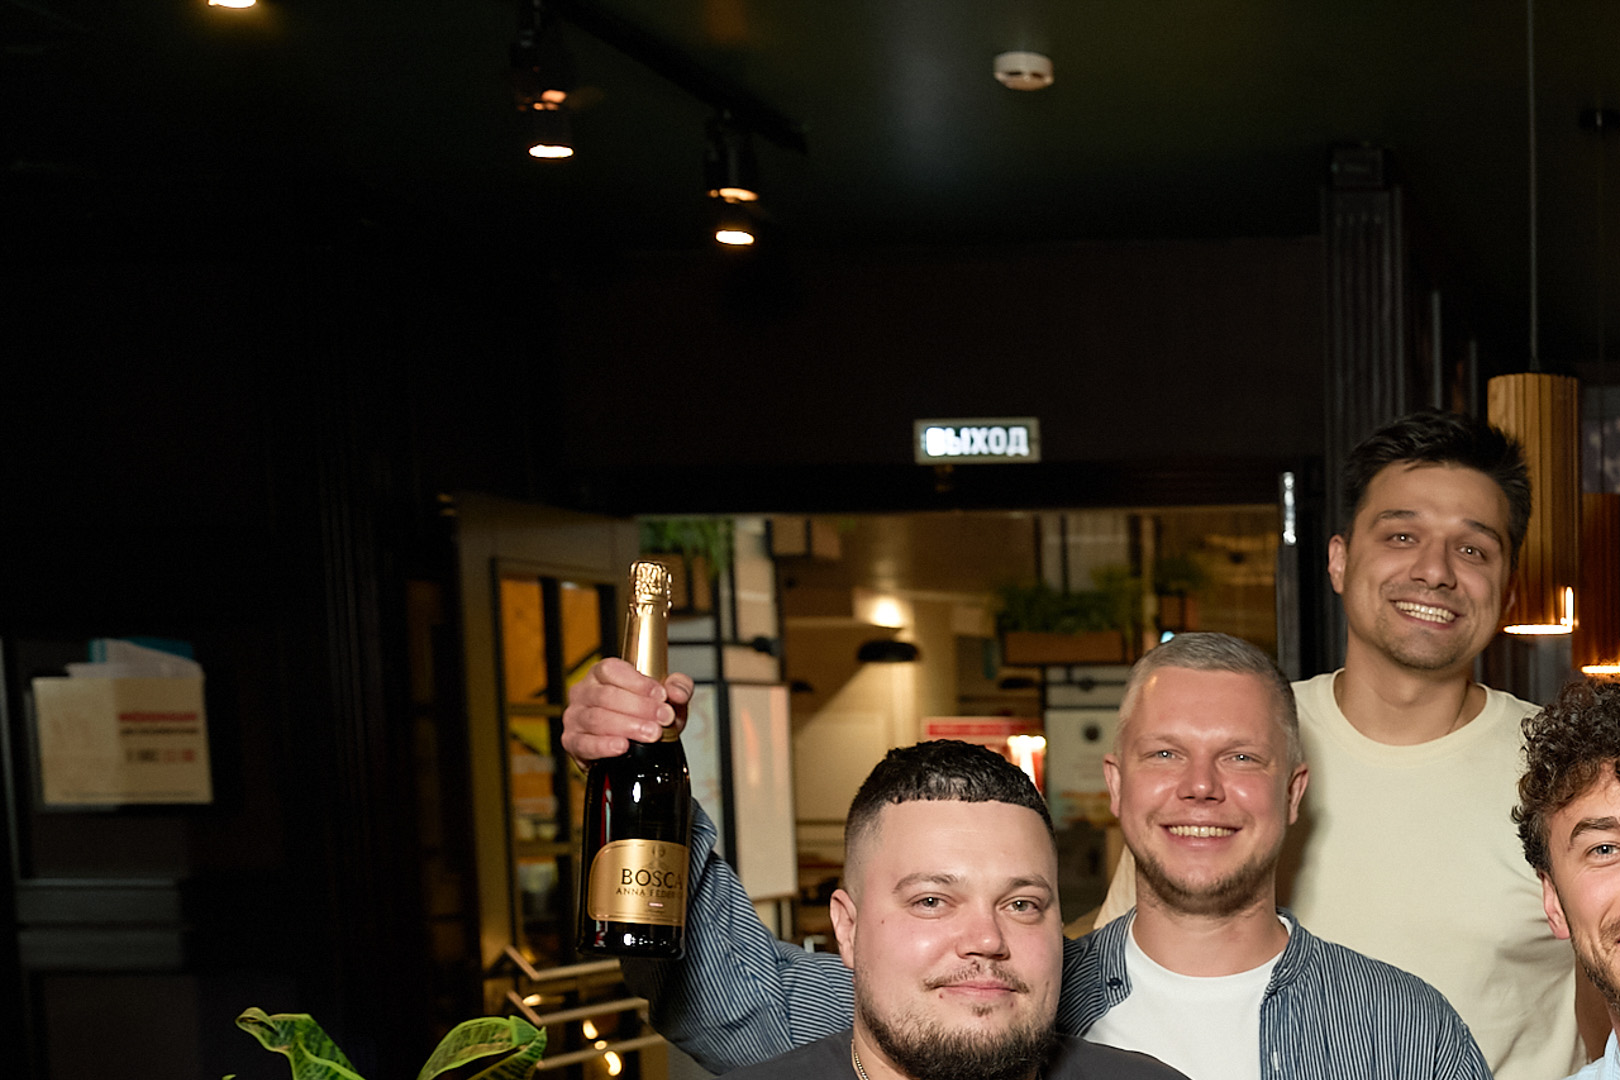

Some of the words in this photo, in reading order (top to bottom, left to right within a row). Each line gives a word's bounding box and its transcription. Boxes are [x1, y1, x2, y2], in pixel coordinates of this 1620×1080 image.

[926, 427, 1029, 456] ВЫХОД
[621, 868, 683, 890] BOSCA
[616, 887, 646, 897] ANNA
